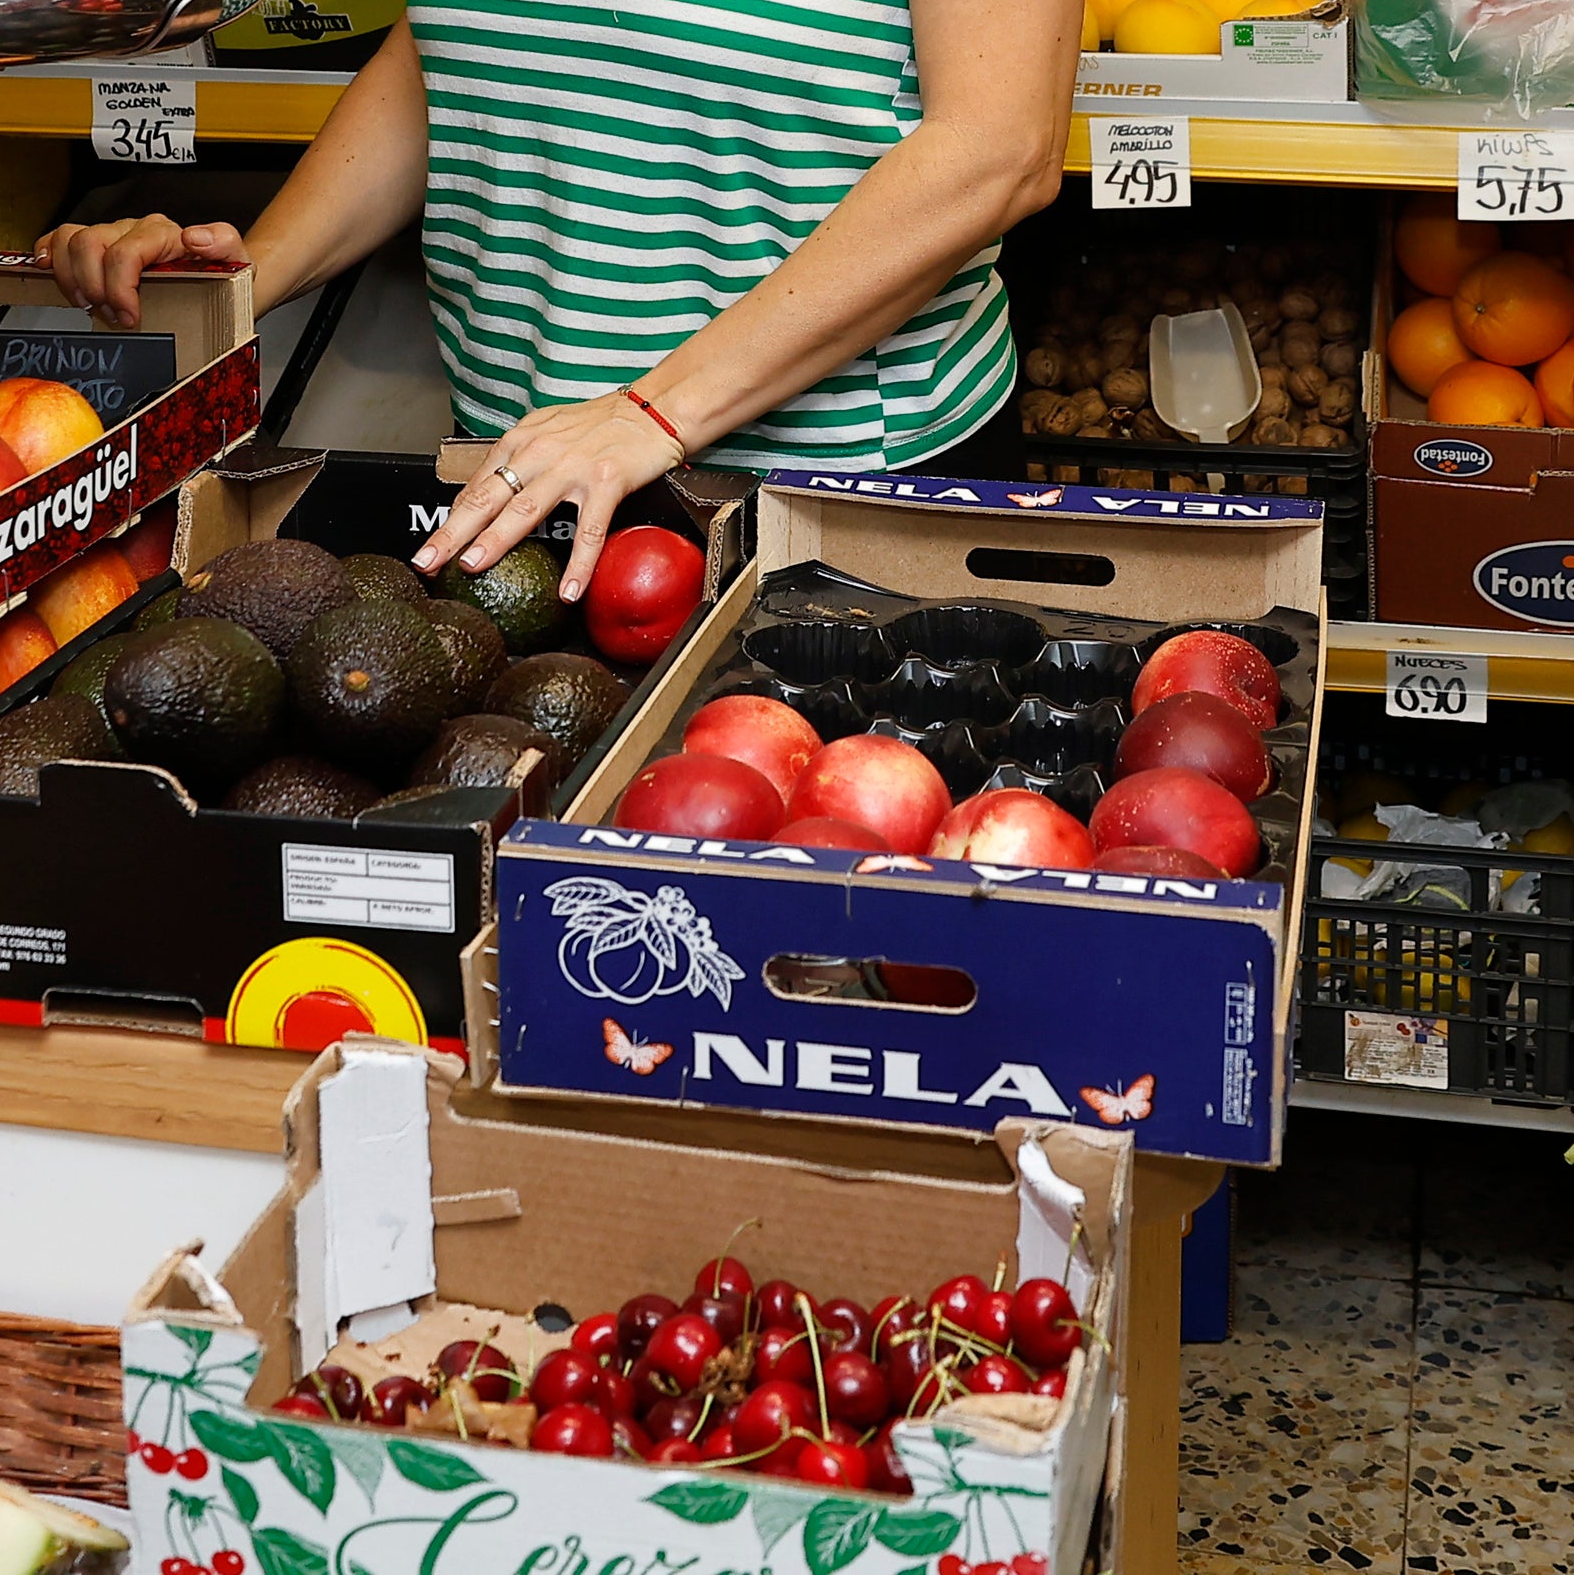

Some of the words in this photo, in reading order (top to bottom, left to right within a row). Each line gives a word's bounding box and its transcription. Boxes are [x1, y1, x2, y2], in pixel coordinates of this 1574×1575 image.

[267, 17, 349, 33] FACTORY
[1312, 32, 1331, 40] CAT
[97, 81, 171, 96] MANZANA
[105, 96, 163, 112] GOLDEN
[161, 104, 196, 119] EXTRA
[110, 118, 174, 164] 3,45
[1473, 165, 1567, 216] 5,75
[1419, 444, 1489, 463] Fontestad
[807, 475, 987, 503] NELA
[1090, 494, 1271, 518] NELA
[1395, 655, 1468, 674] NUECES
[578, 825, 817, 865] NELA
[967, 862, 1221, 901] NELA
[691, 1031, 1072, 1118] NELA
